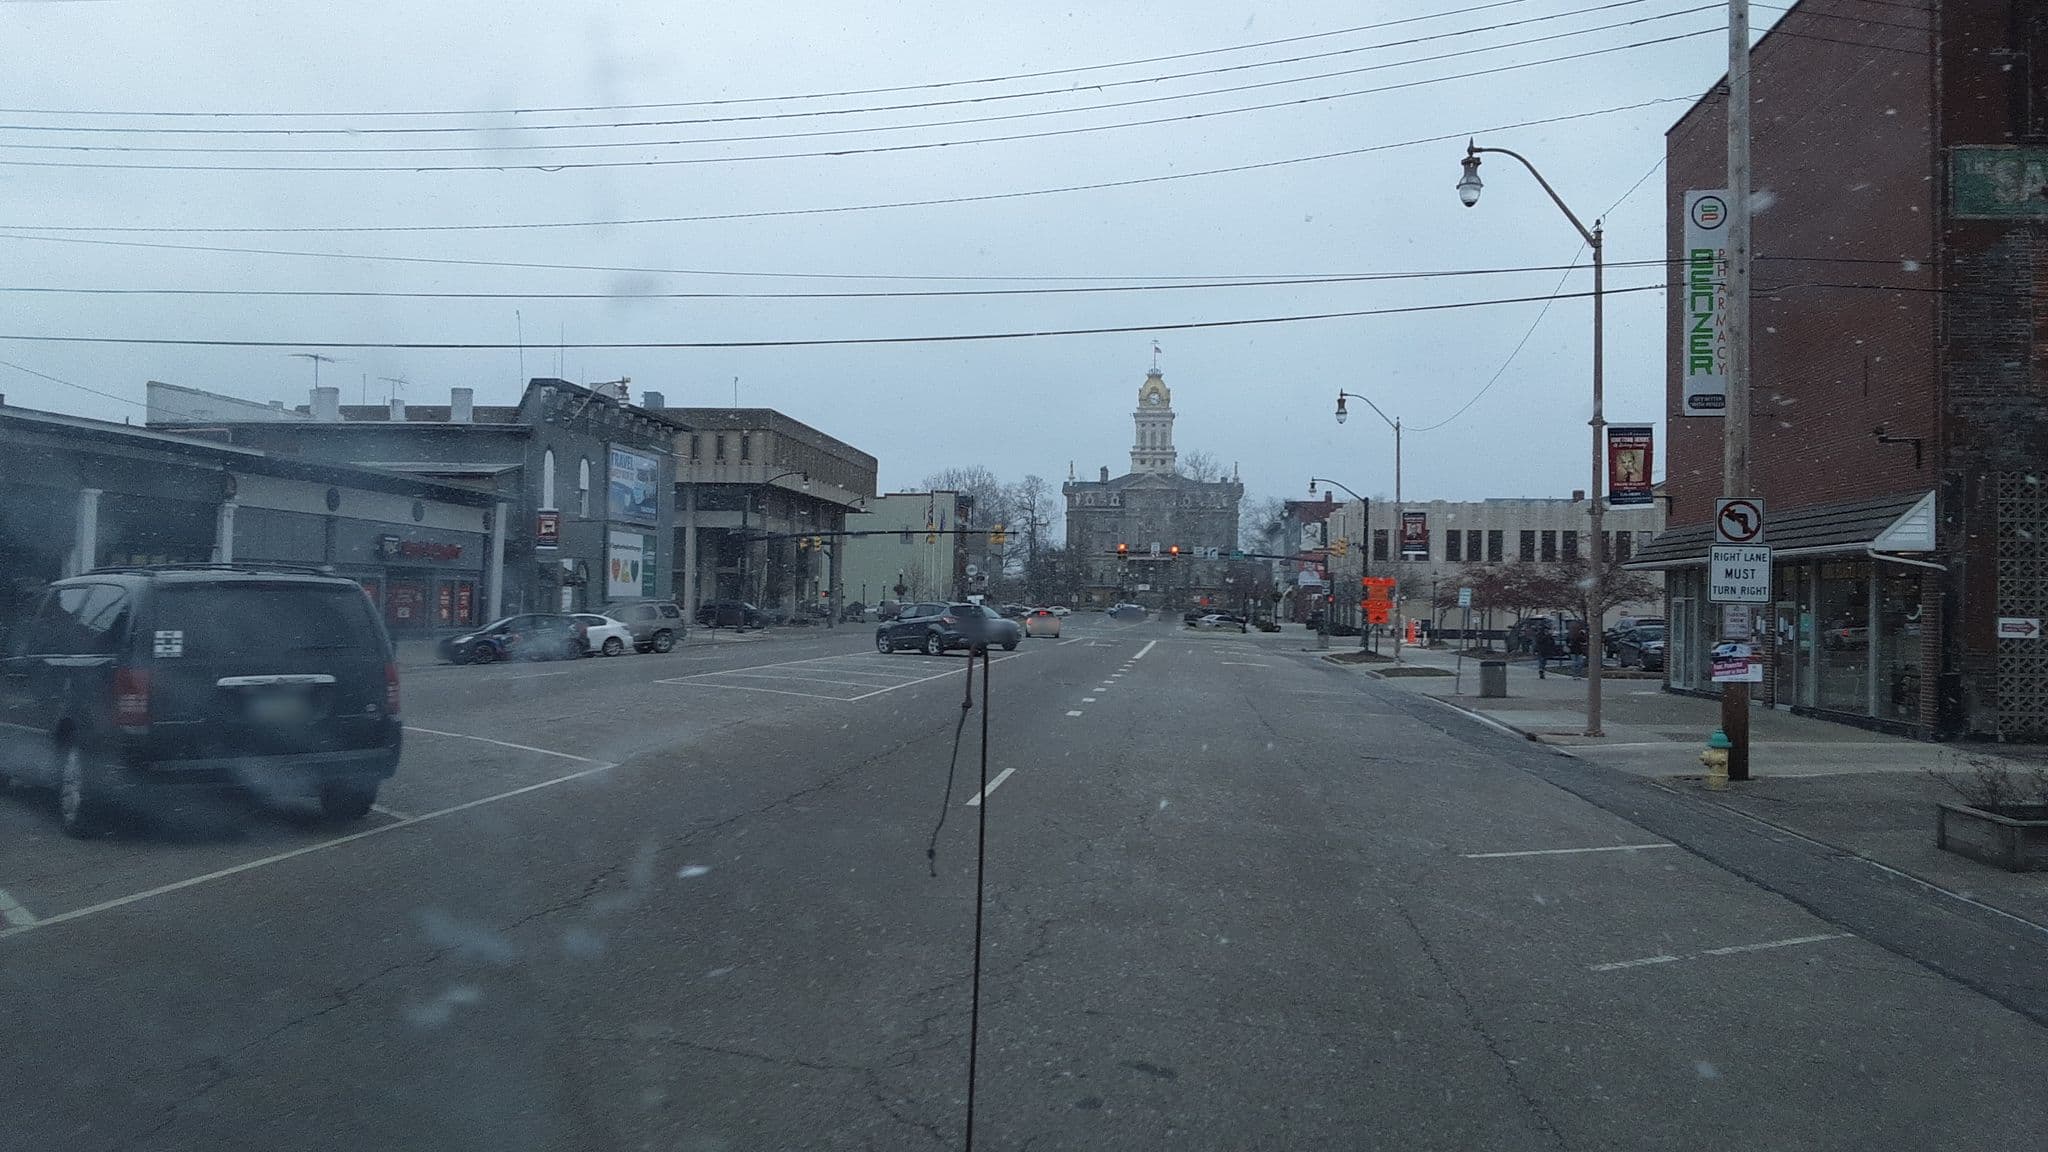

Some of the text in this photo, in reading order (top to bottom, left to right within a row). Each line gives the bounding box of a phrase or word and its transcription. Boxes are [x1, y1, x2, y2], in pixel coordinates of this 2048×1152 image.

[1691, 249, 1714, 375] BENZER
[1716, 249, 1727, 375] PHARMACY
[1714, 552, 1768, 563] RIGHT LANE
[1724, 568, 1756, 580] MUST
[1713, 585, 1767, 596] TURN RIGHT
